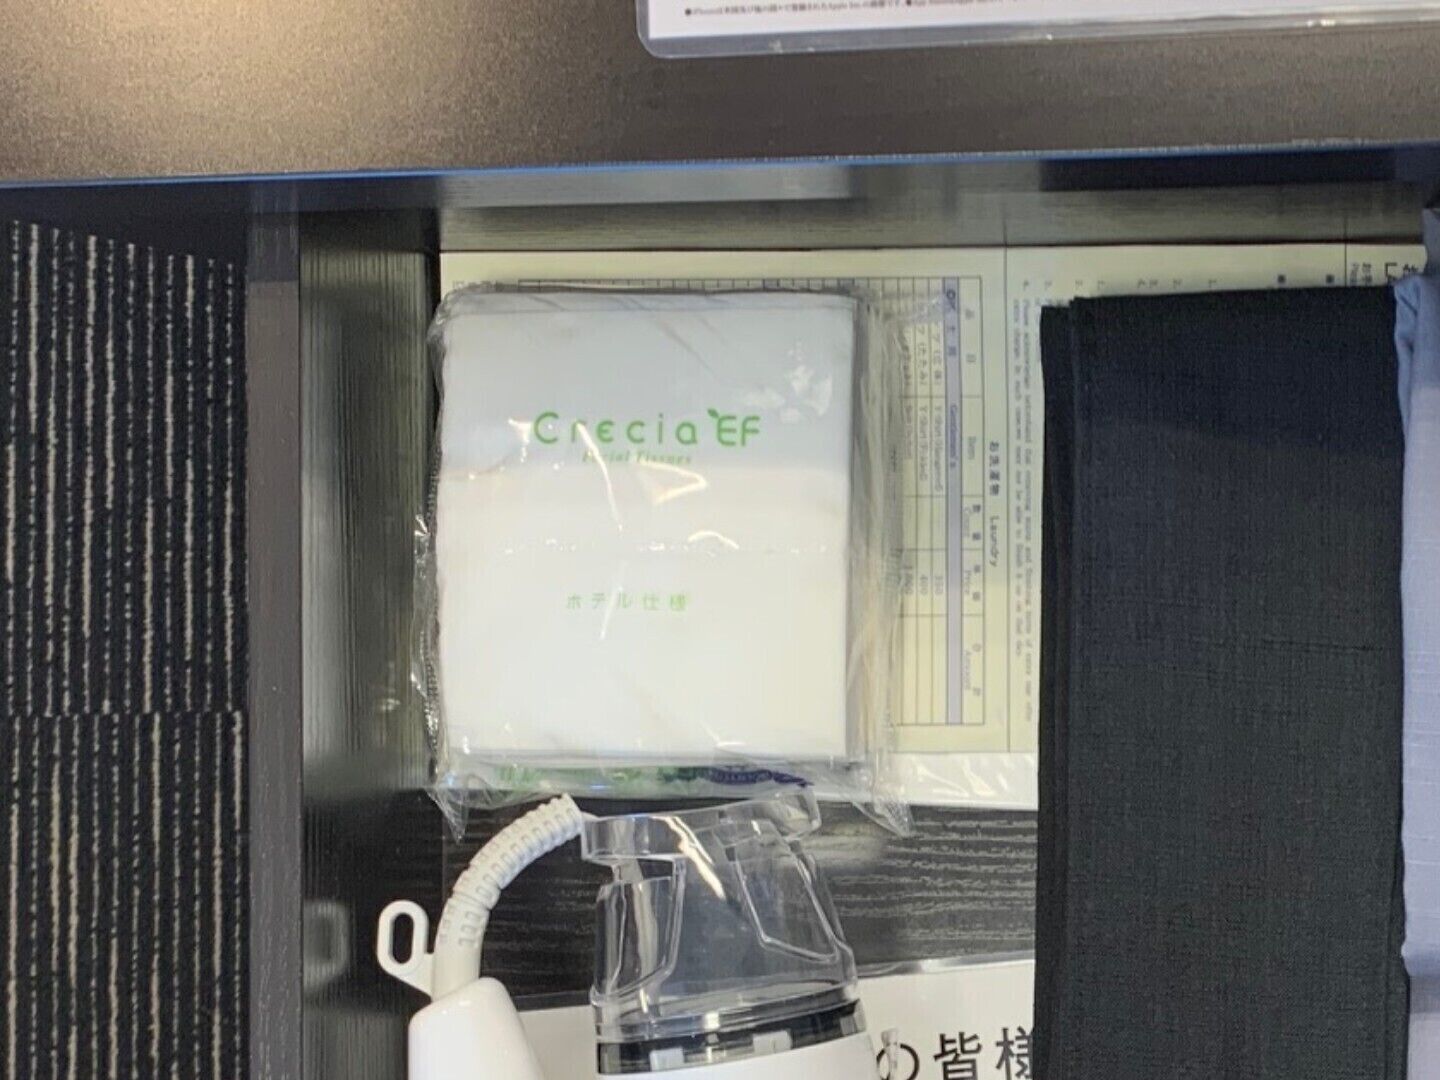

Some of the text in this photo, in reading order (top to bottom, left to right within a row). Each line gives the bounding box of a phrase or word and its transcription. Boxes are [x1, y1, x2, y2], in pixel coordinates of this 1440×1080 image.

[533, 412, 761, 447] Crecia EF
[989, 515, 1000, 568] Laundry
[566, 592, 687, 612] ホテル仕様
